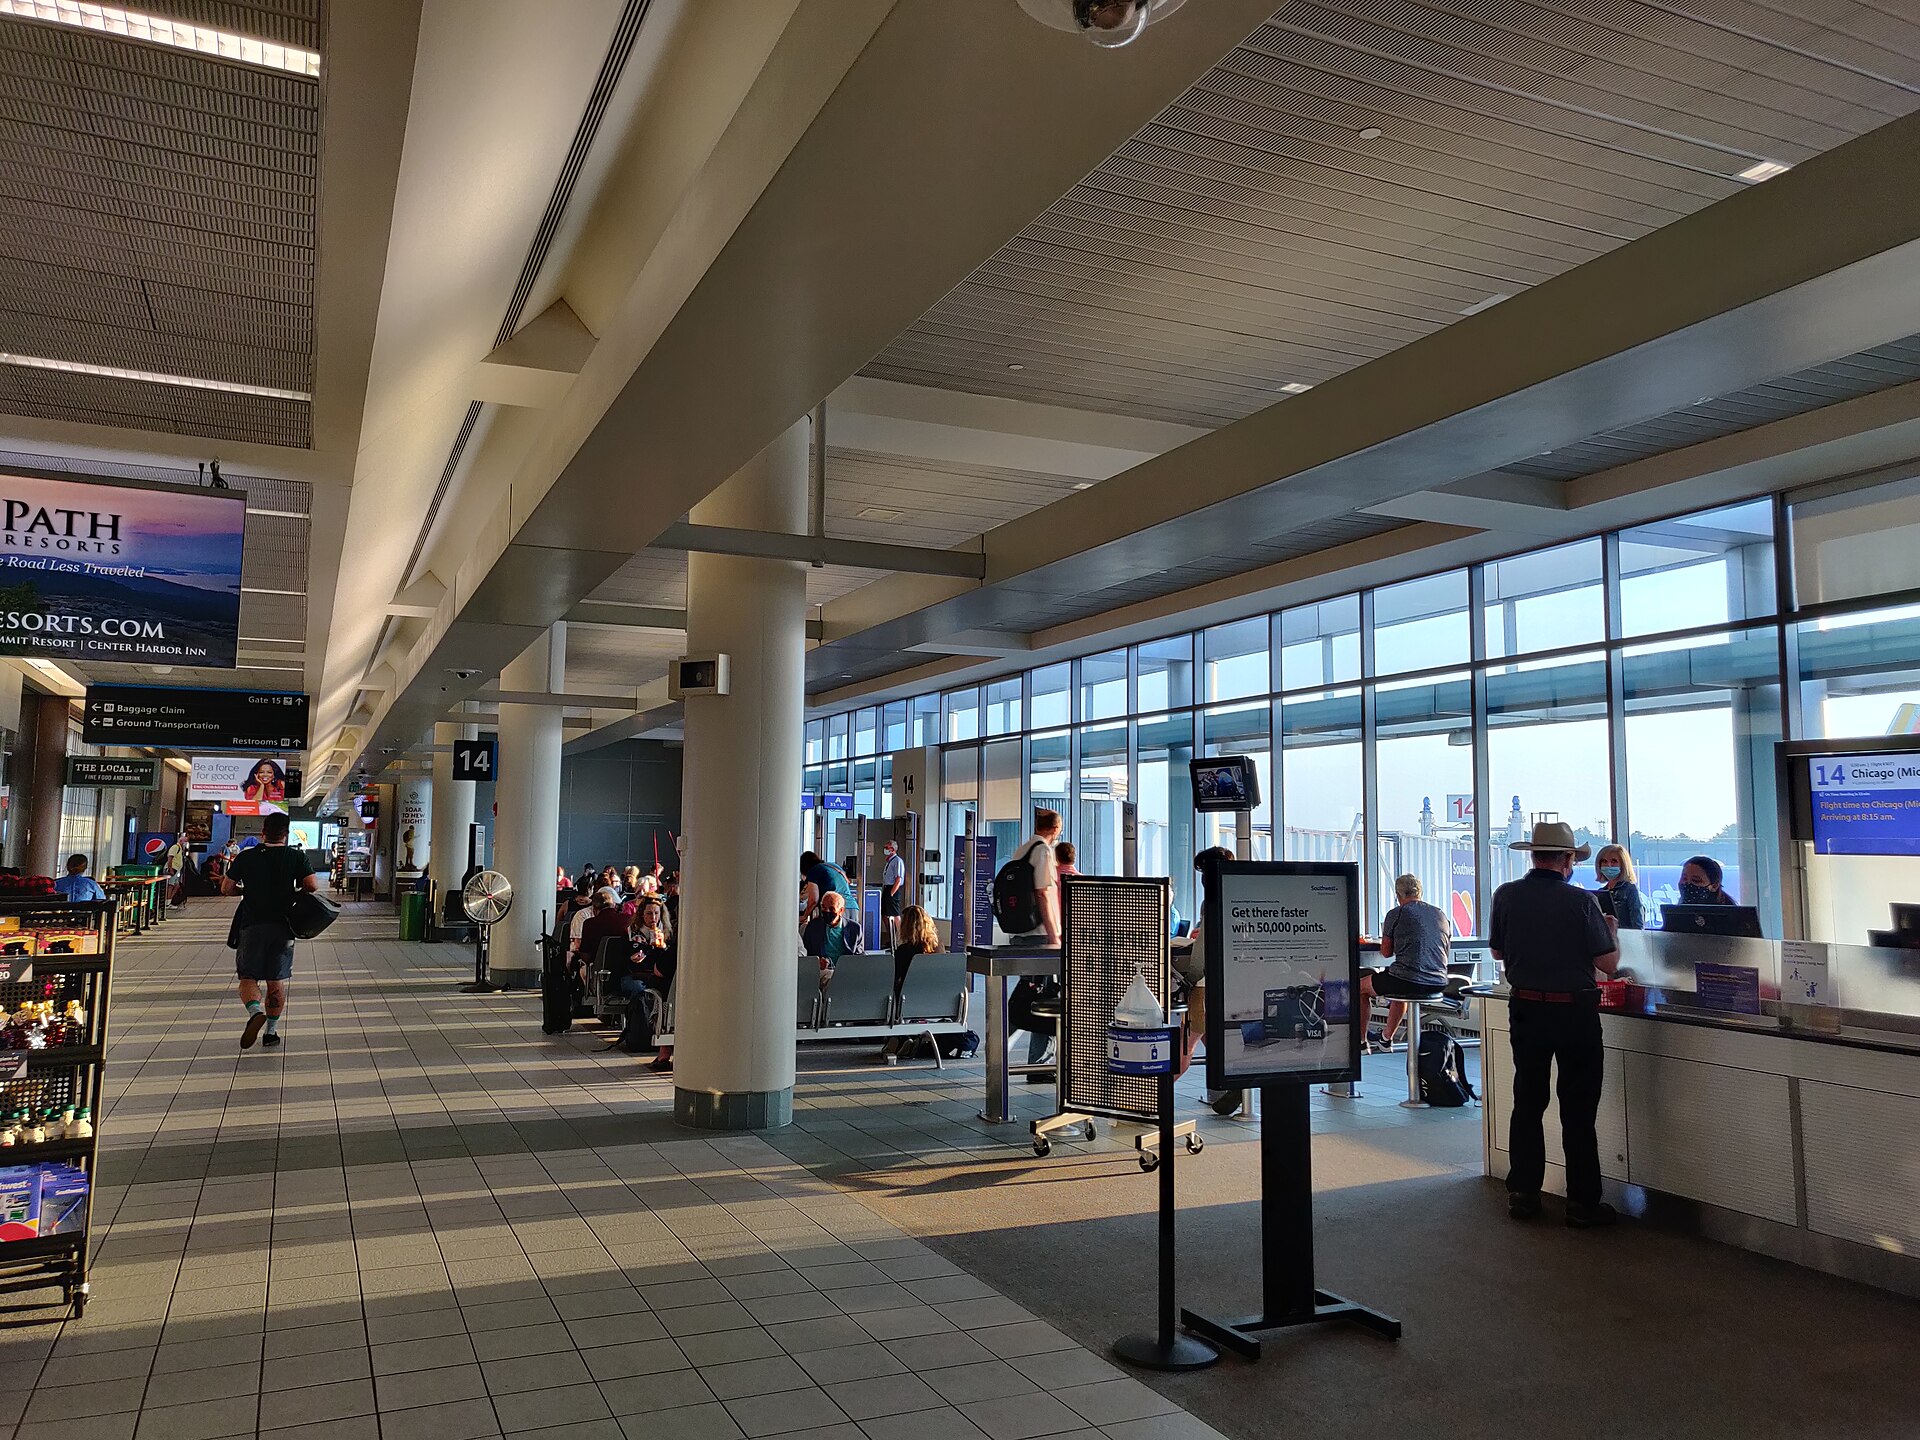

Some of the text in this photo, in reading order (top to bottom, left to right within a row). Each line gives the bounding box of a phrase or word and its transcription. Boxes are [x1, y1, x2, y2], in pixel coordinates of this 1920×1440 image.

[2, 499, 122, 541] PATH
[5, 534, 120, 555] RESORTS
[7, 556, 46, 570] Road
[49, 560, 80, 573] Less
[84, 563, 145, 578] Traveled
[32, 636, 76, 648] RESORT
[88, 640, 133, 652] CENTER
[136, 643, 182, 655] HARBOR
[185, 646, 207, 656] INN
[248, 696, 269, 704] Gate
[117, 705, 185, 714] Baggage Claim
[116, 719, 220, 730] Ground Transportation
[232, 737, 278, 746] Restrooms
[460, 750, 490, 772] 14
[75, 763, 97, 772] THE
[100, 764, 133, 773] LOCAL
[193, 763, 206, 771] Be
[215, 763, 240, 772] force
[196, 772, 209, 780] for
[1816, 764, 1846, 786] 14
[1851, 768, 1895, 780] Chicago
[903, 775, 914, 794] 14
[1820, 802, 1841, 810] Flight
[1843, 801, 1860, 809] time
[1871, 800, 1903, 809] Chicago
[1821, 813, 1851, 823] Arriving
[1861, 813, 1878, 821] 8:15
[1231, 906, 1309, 918] Get there faster
[1232, 921, 1327, 935] with 50,000 points.
[1306, 1029, 1322, 1037] VISA
